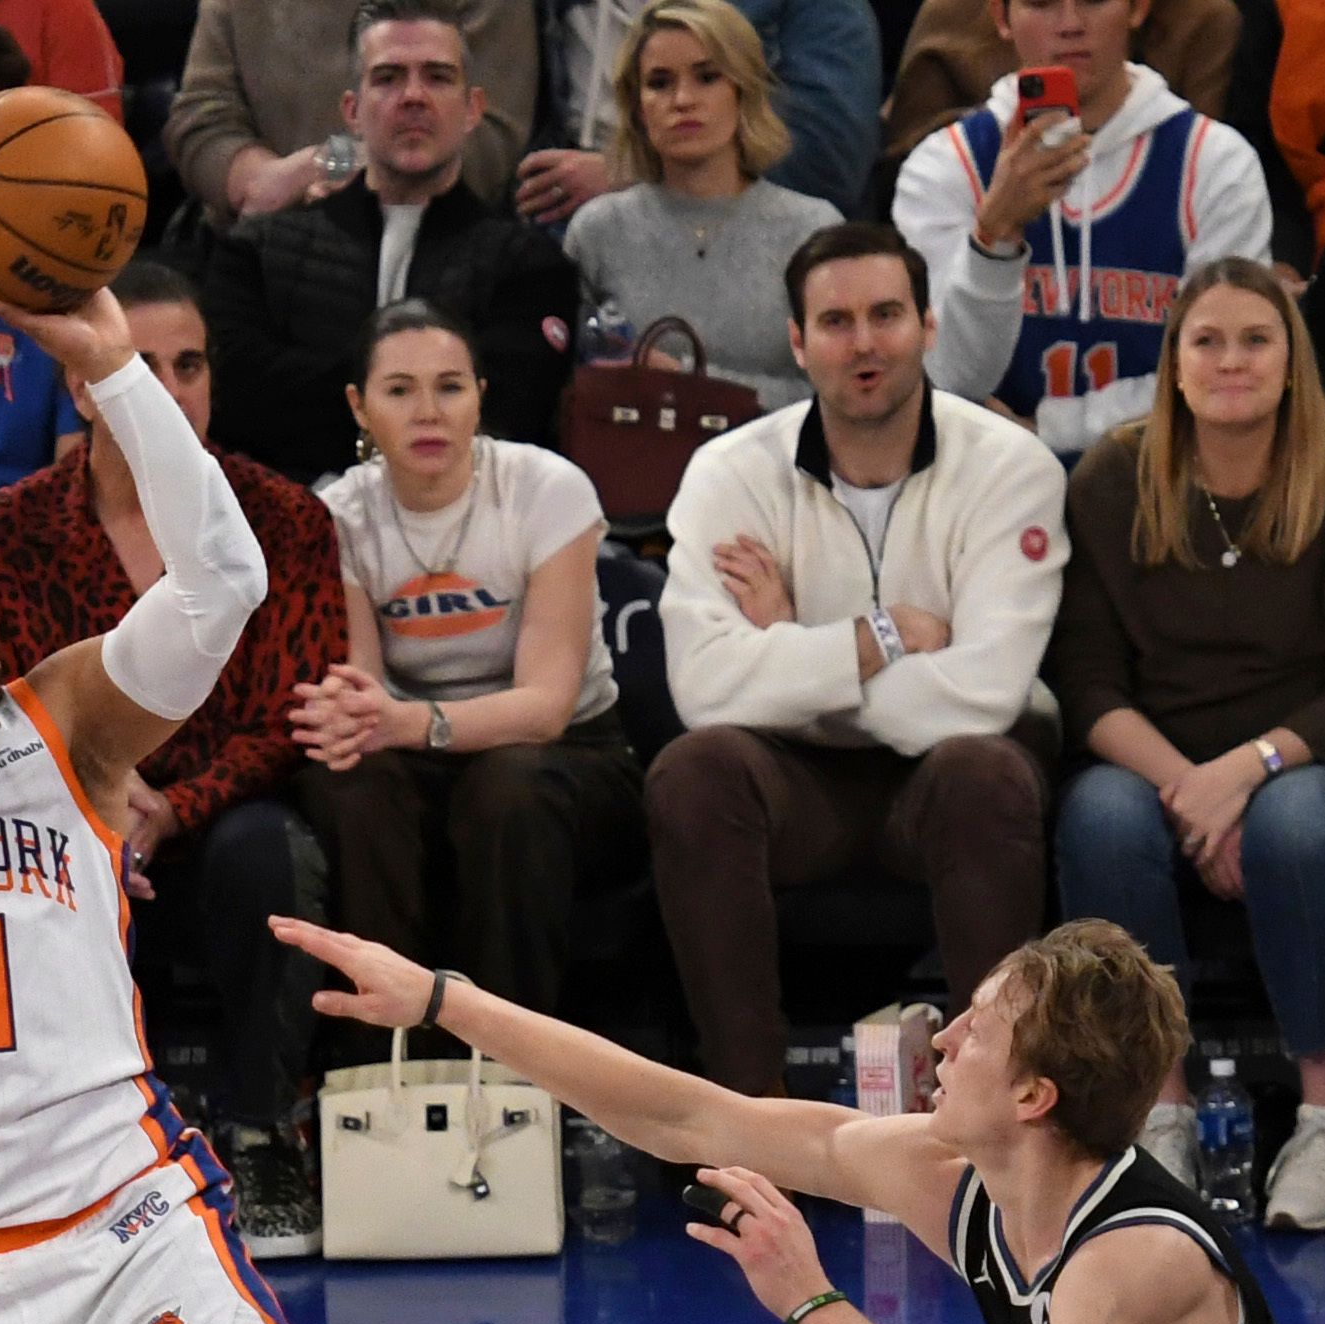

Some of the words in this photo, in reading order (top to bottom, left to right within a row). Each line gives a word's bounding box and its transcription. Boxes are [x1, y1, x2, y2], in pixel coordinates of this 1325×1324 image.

[1022, 266, 1075, 317] EW
[1041, 340, 1118, 397] 11
[377, 587, 511, 618] GIRL
[109, 1191, 169, 1244] NYC
